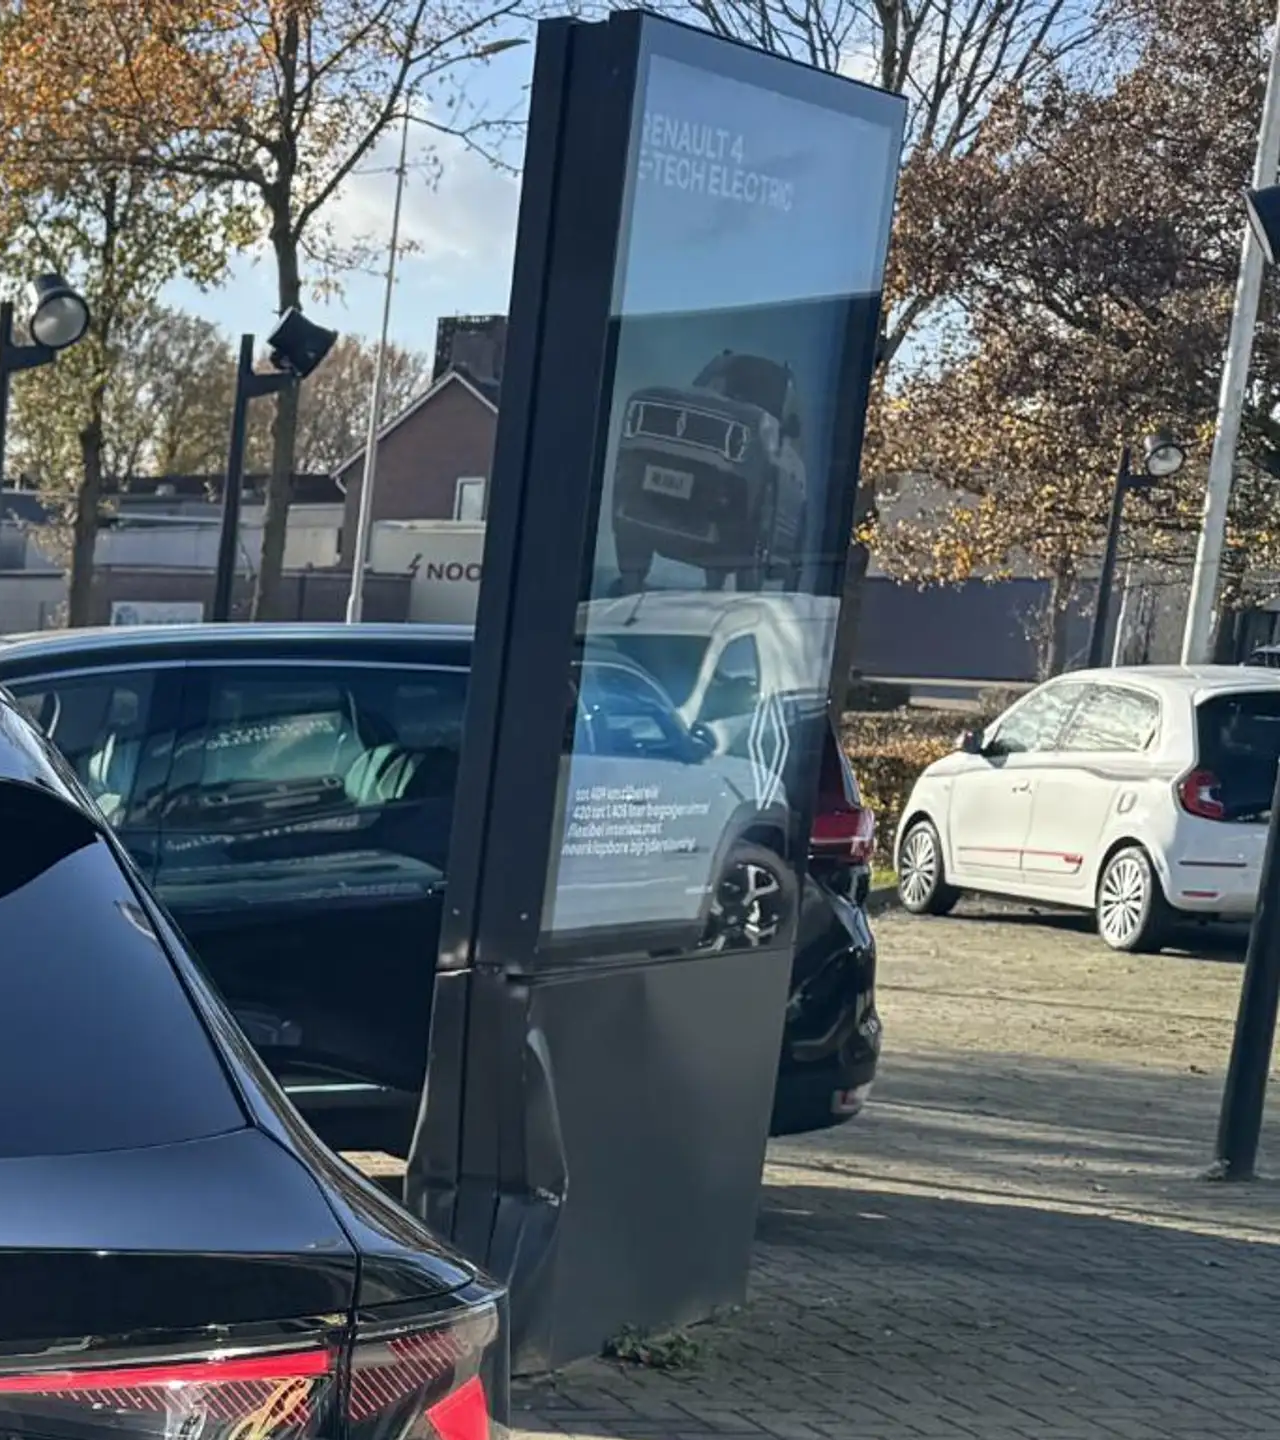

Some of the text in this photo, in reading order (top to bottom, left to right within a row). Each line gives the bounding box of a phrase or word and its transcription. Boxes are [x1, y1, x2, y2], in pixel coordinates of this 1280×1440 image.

[730, 134, 744, 164] 4
[707, 163, 794, 213] ELECTRIC
[426, 562, 482, 581] NOO
